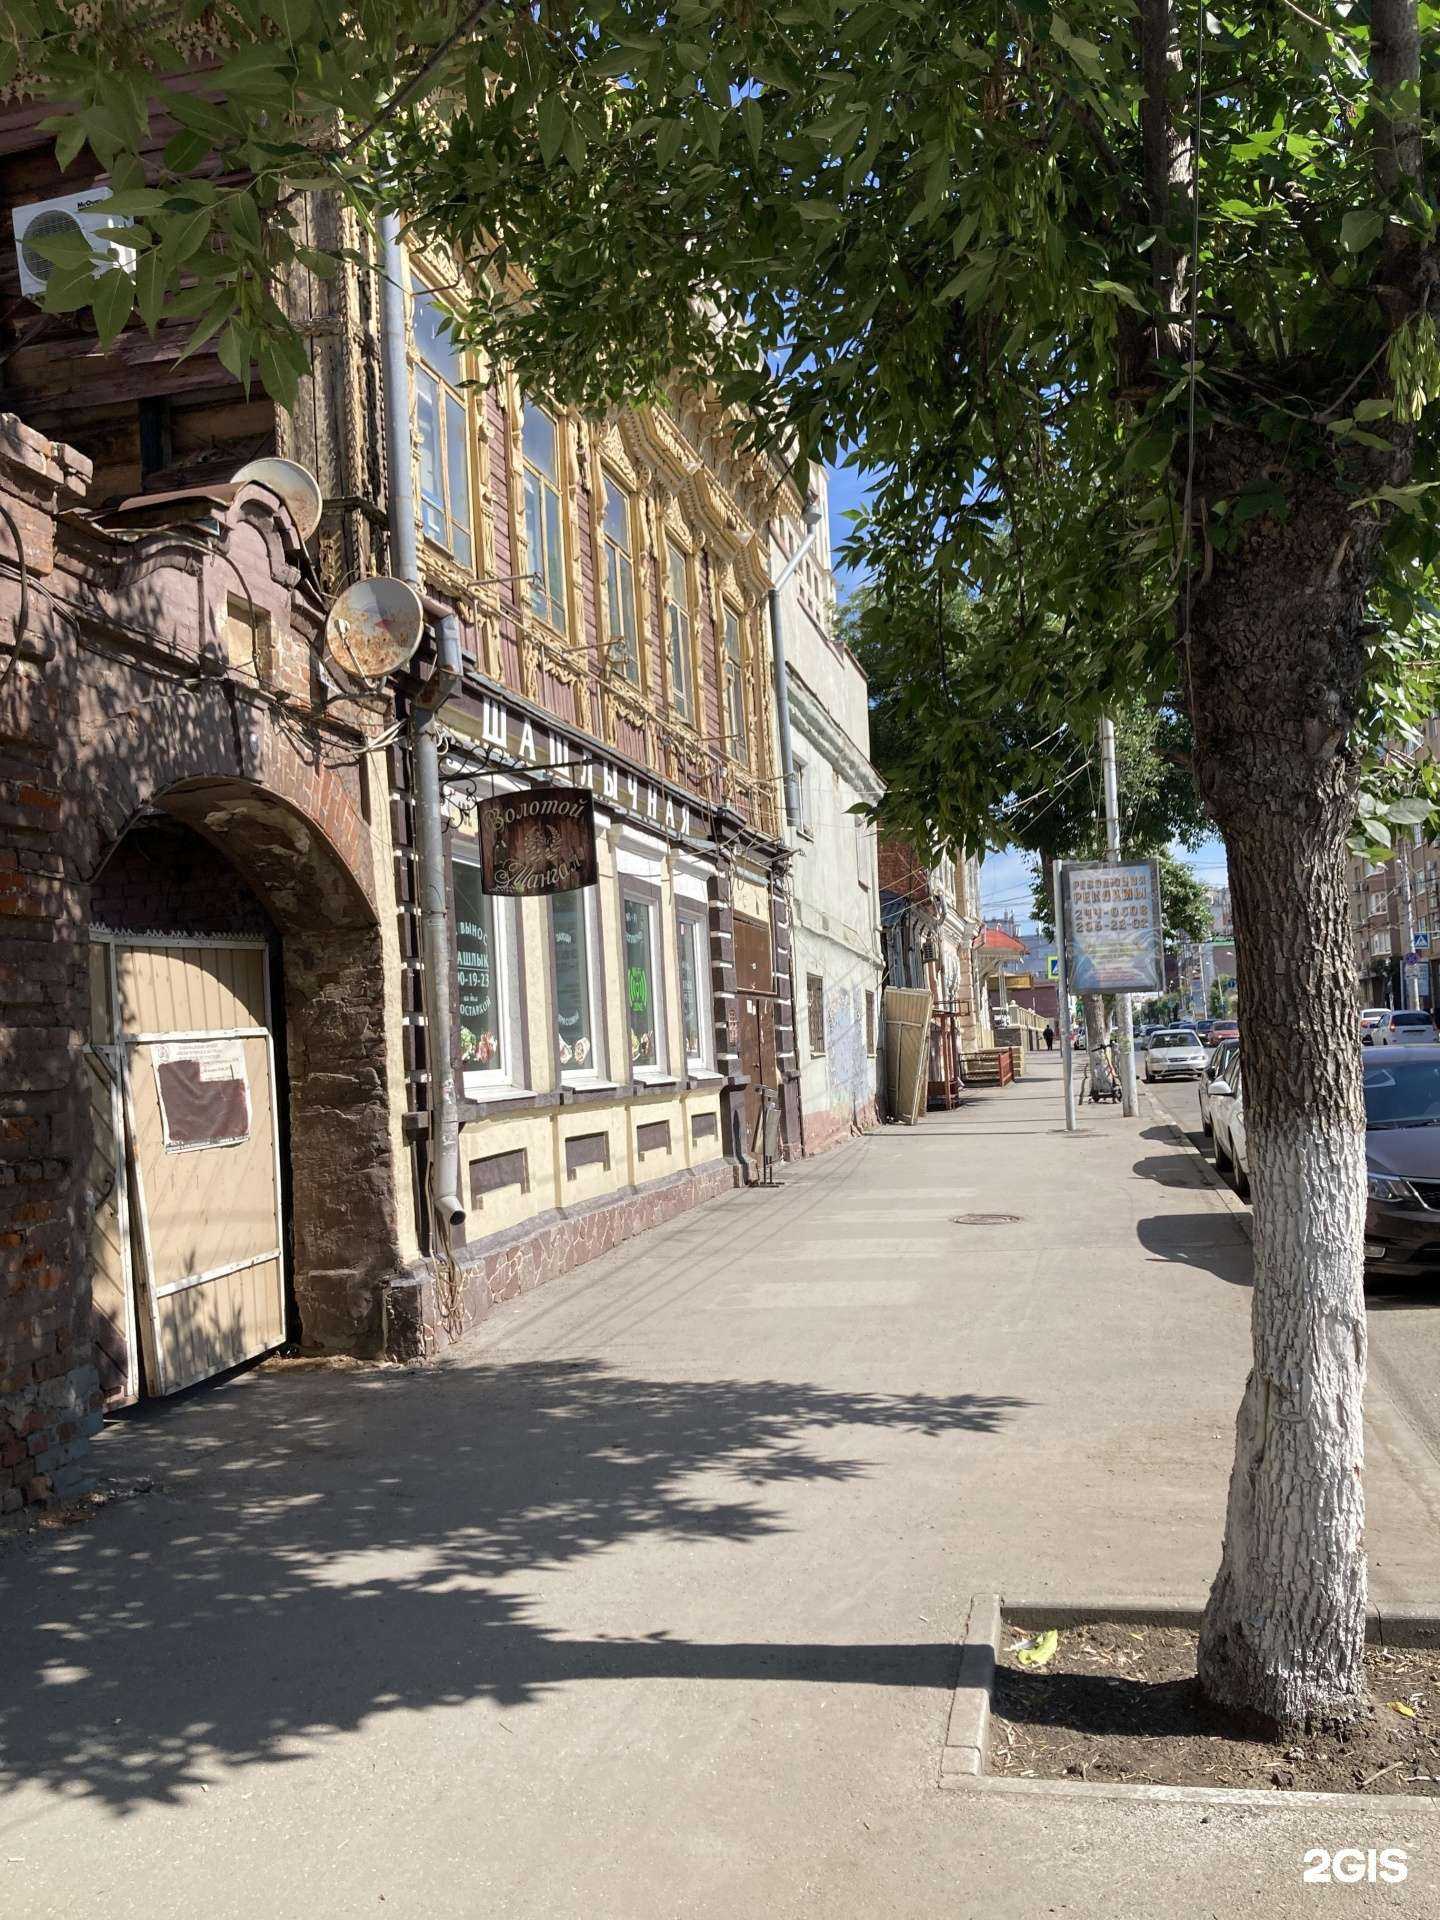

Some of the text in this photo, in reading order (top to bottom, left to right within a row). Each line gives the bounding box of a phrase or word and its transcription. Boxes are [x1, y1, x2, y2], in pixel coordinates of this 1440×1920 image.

[482, 695, 690, 836] ШАШЛЫЧНАЯ
[484, 798, 588, 832] Золотой
[494, 853, 582, 889] Мангал
[460, 922, 488, 946] ВЫНОС
[457, 951, 489, 968] АШЛЫК
[459, 996, 491, 1016] ОСТАВКОЙ
